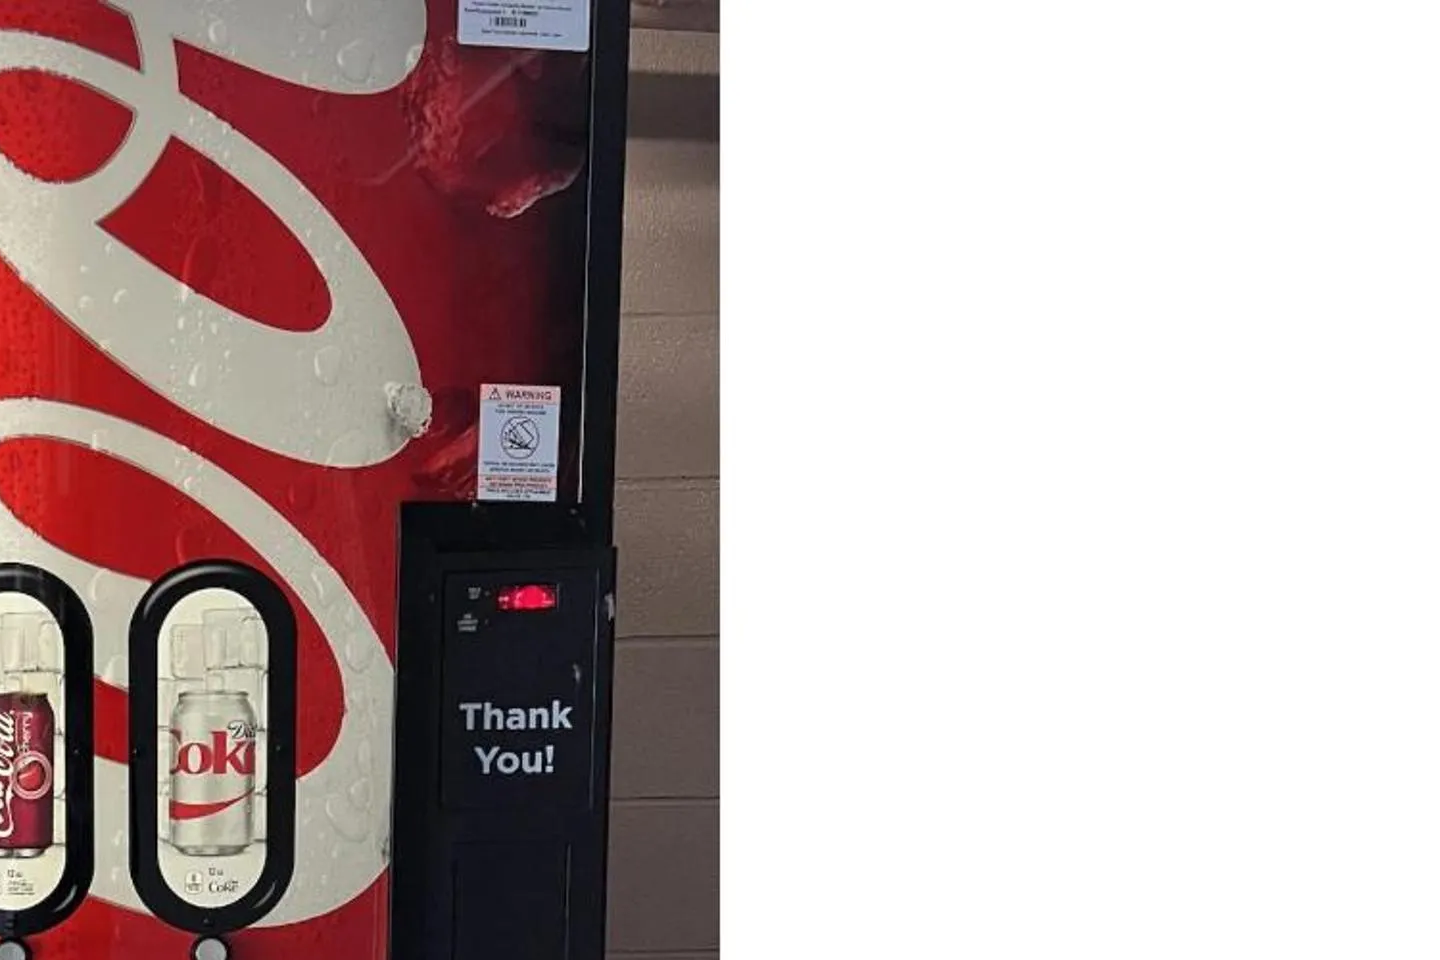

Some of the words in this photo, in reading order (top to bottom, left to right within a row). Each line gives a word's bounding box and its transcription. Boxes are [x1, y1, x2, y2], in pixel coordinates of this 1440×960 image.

[505, 390, 552, 401] WARNING
[459, 700, 573, 730] Thank
[474, 745, 555, 774] You!
